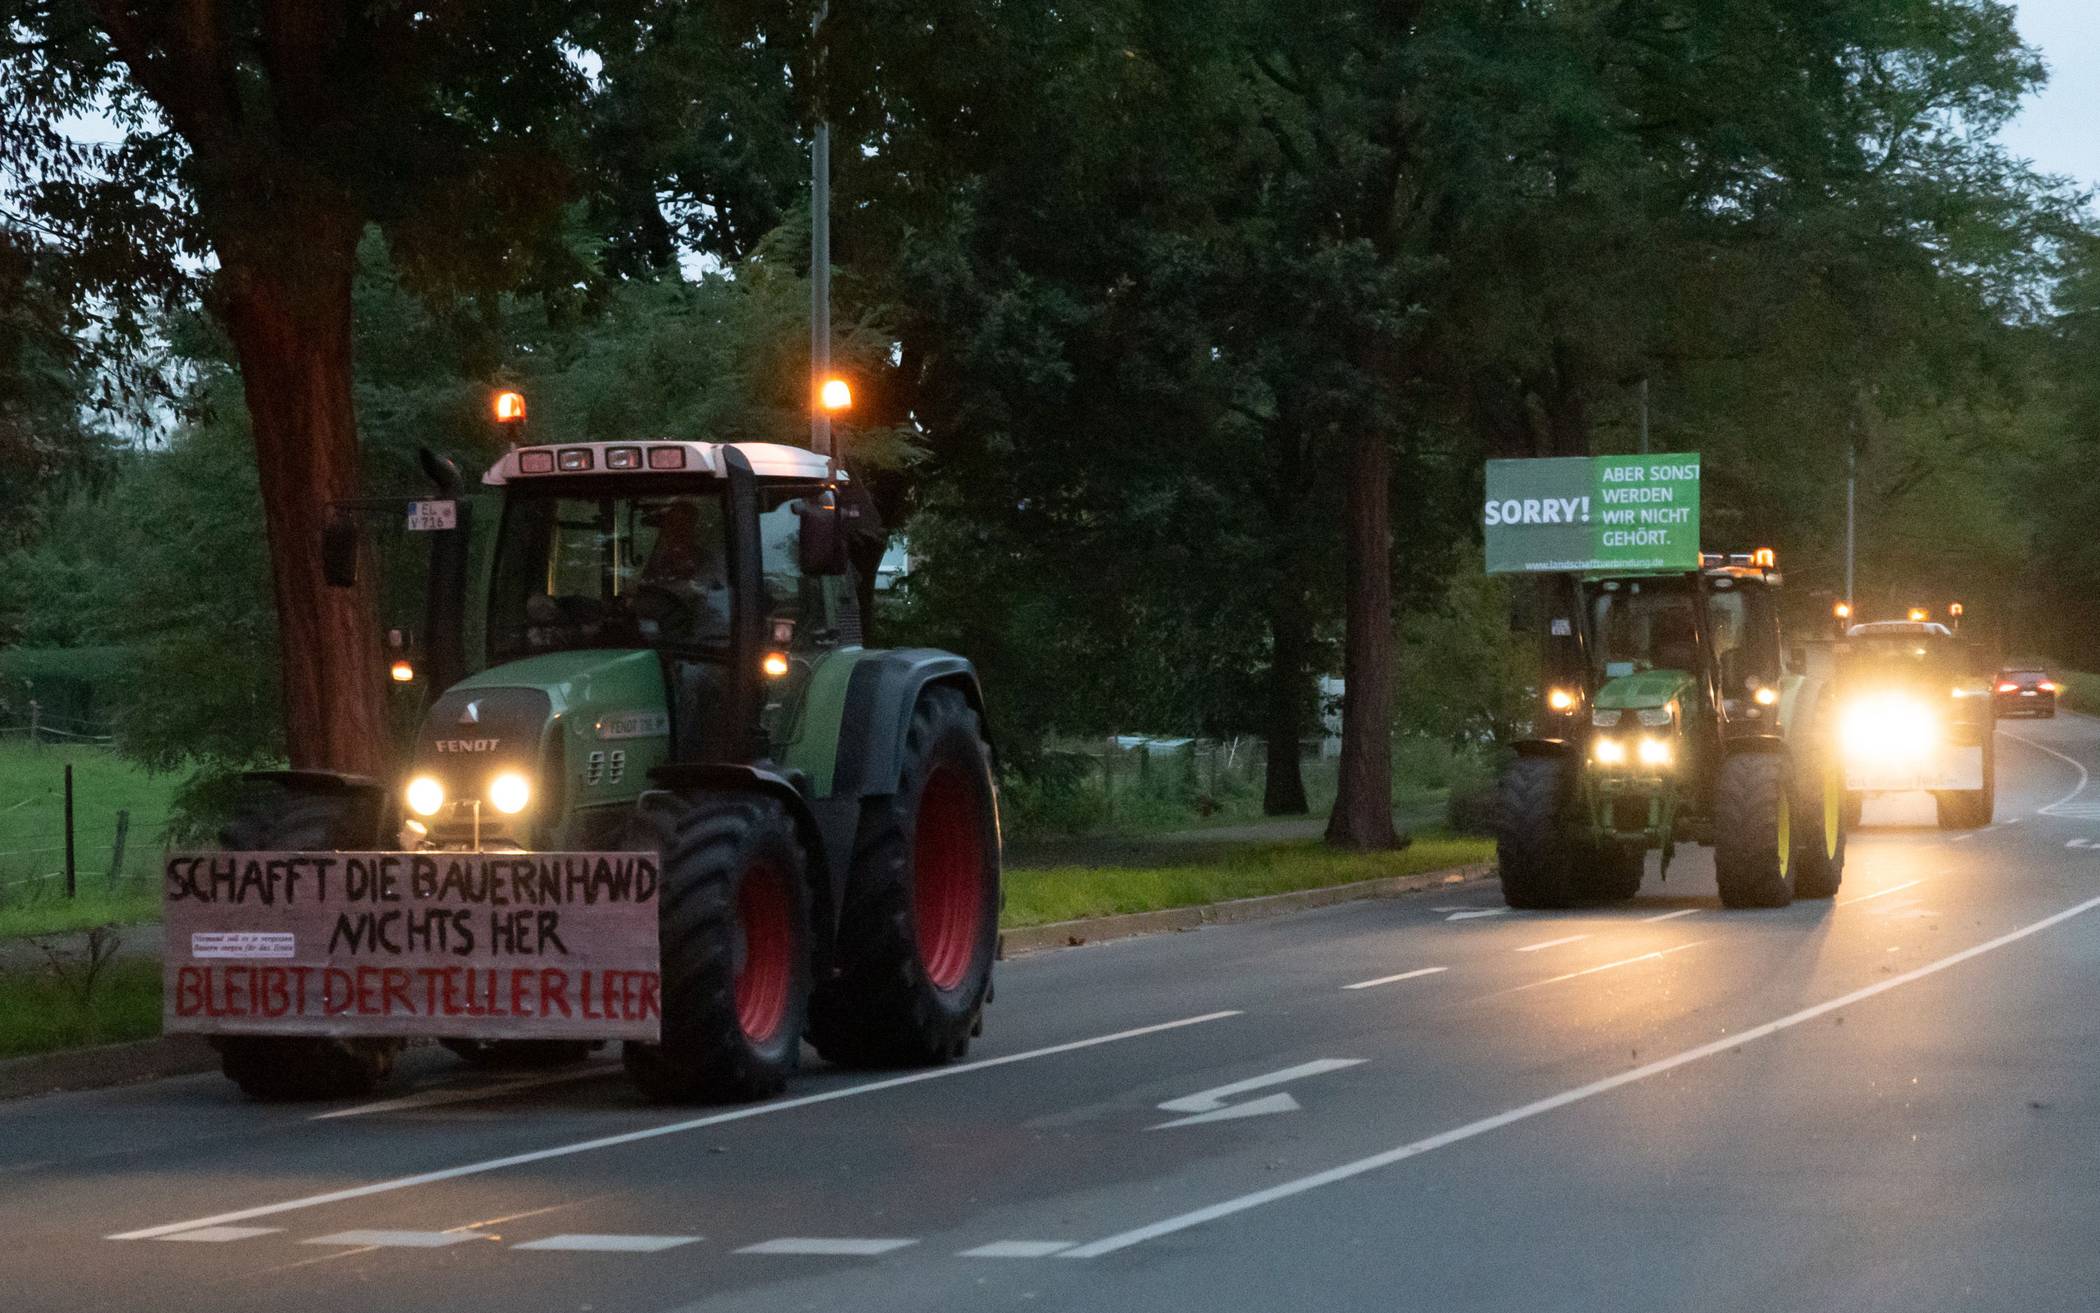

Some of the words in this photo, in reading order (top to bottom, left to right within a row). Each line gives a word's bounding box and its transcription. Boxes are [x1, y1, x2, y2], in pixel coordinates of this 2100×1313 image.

[1602, 466, 1644, 482] ABER
[1649, 464, 1700, 482] SONST
[1602, 487, 1673, 504] WERDEN
[1485, 496, 1590, 525] SORRY!
[1602, 509, 1635, 524] WIR
[1641, 508, 1690, 523] NICHT
[1602, 527, 1671, 546] GEHÖRT.
[435, 738, 500, 753] FENDT
[167, 857, 337, 905] SCHAFFT
[345, 857, 400, 903] DIE
[329, 907, 475, 956] NICHTS
[490, 909, 568, 956] HER
[175, 965, 314, 1017] BLEIBT
[323, 965, 416, 1016] DER
[417, 965, 572, 1017] TELLER
[581, 968, 660, 1020] LEER
